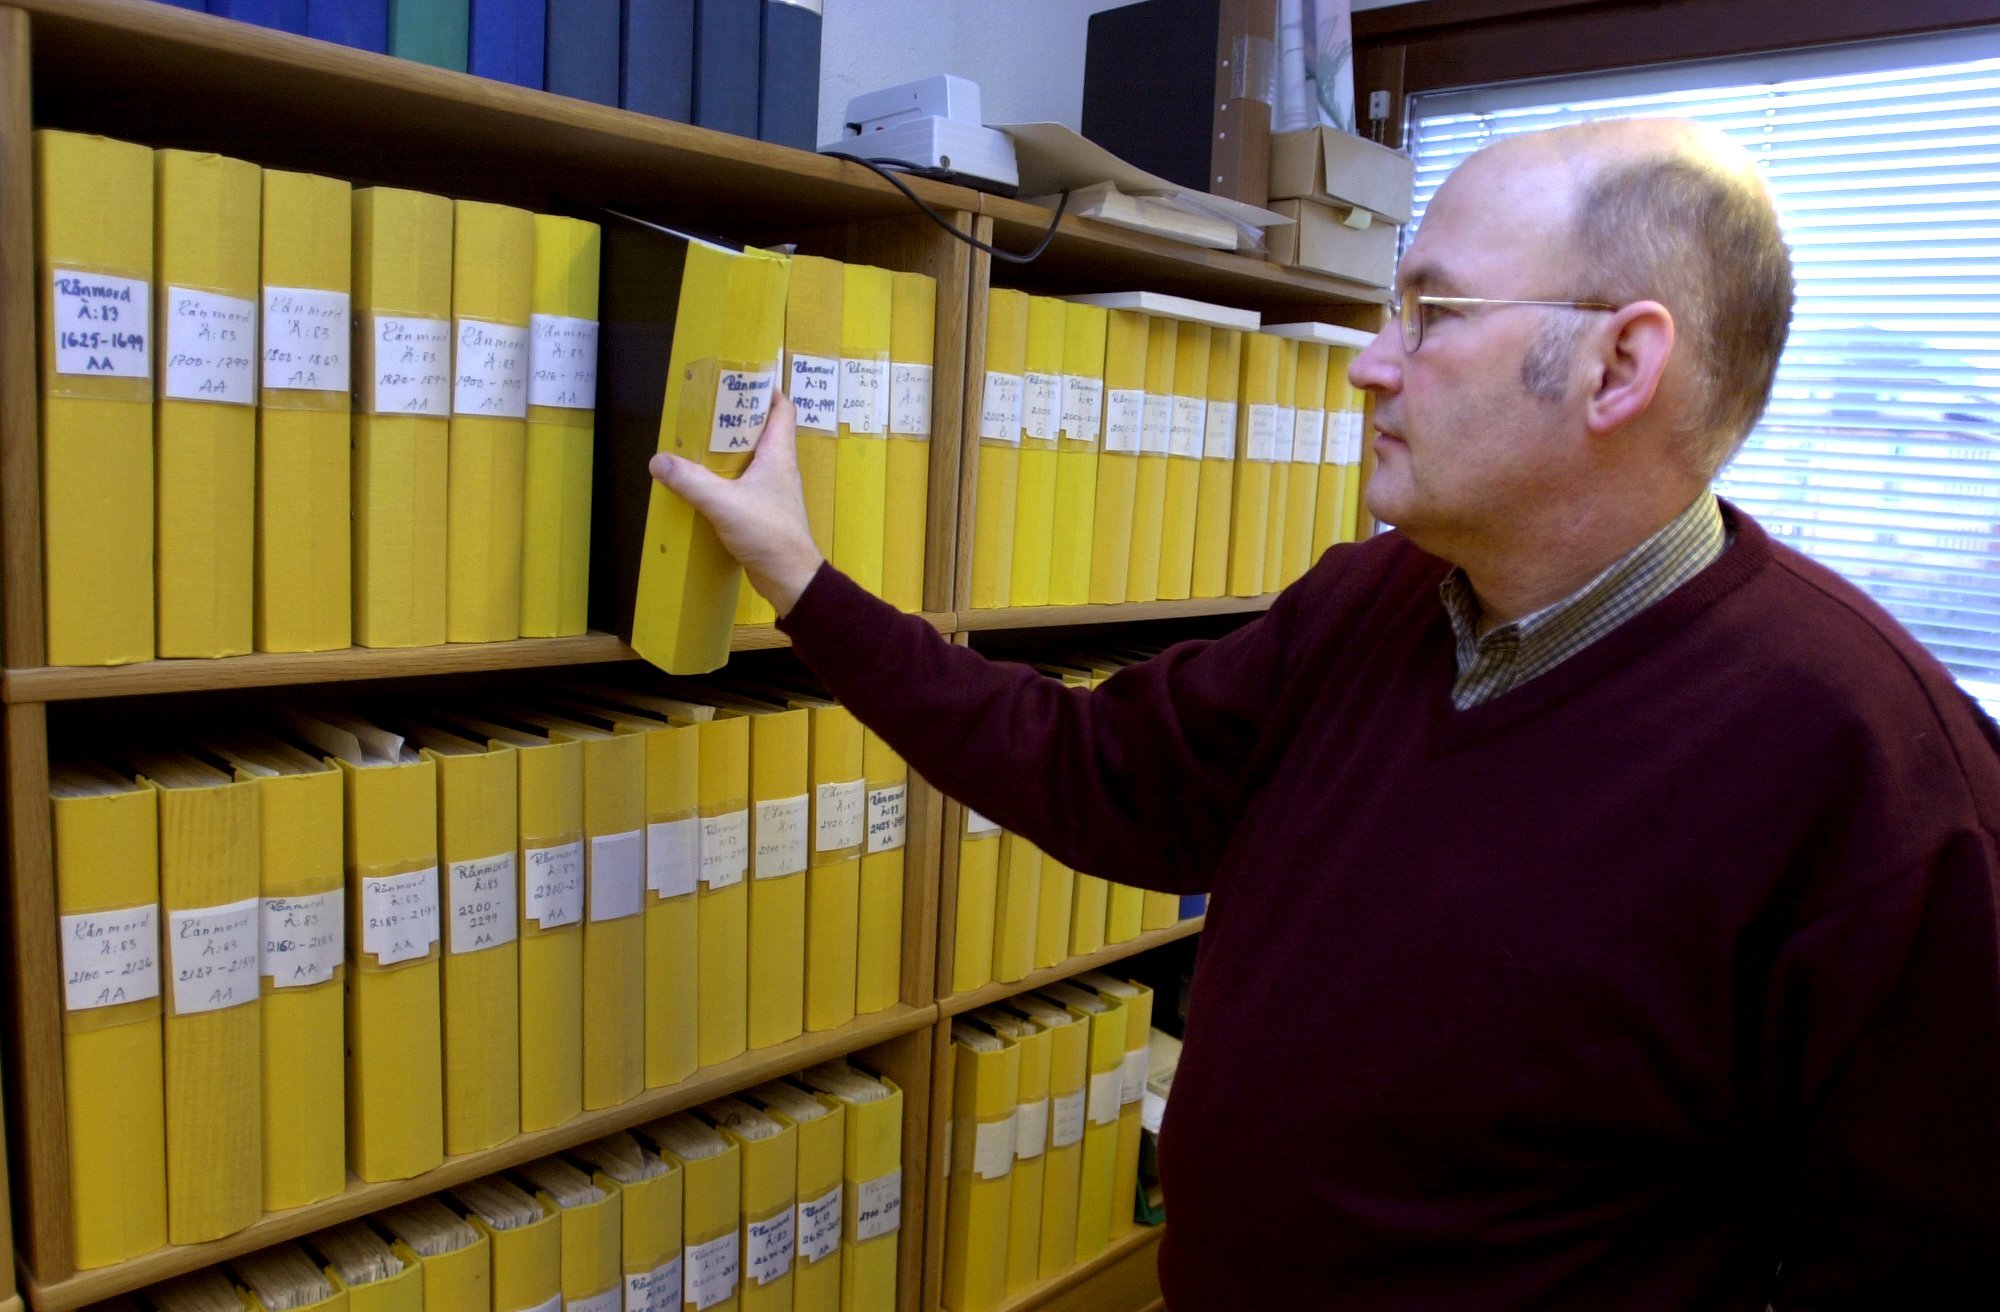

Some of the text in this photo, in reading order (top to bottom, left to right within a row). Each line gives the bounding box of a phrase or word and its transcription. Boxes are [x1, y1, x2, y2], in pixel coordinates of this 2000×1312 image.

[55, 279, 131, 302] Rånmord
[78, 299, 118, 321] Ä:83
[87, 356, 114, 370] AA
[199, 379, 227, 393] AA
[729, 436, 749, 448] AA
[456, 859, 510, 880] Rånmord
[548, 908, 566, 920] AA
[475, 934, 493, 946] AA
[293, 964, 318, 978] AA
[96, 987, 127, 1004] AA
[208, 988, 233, 1003] AA
